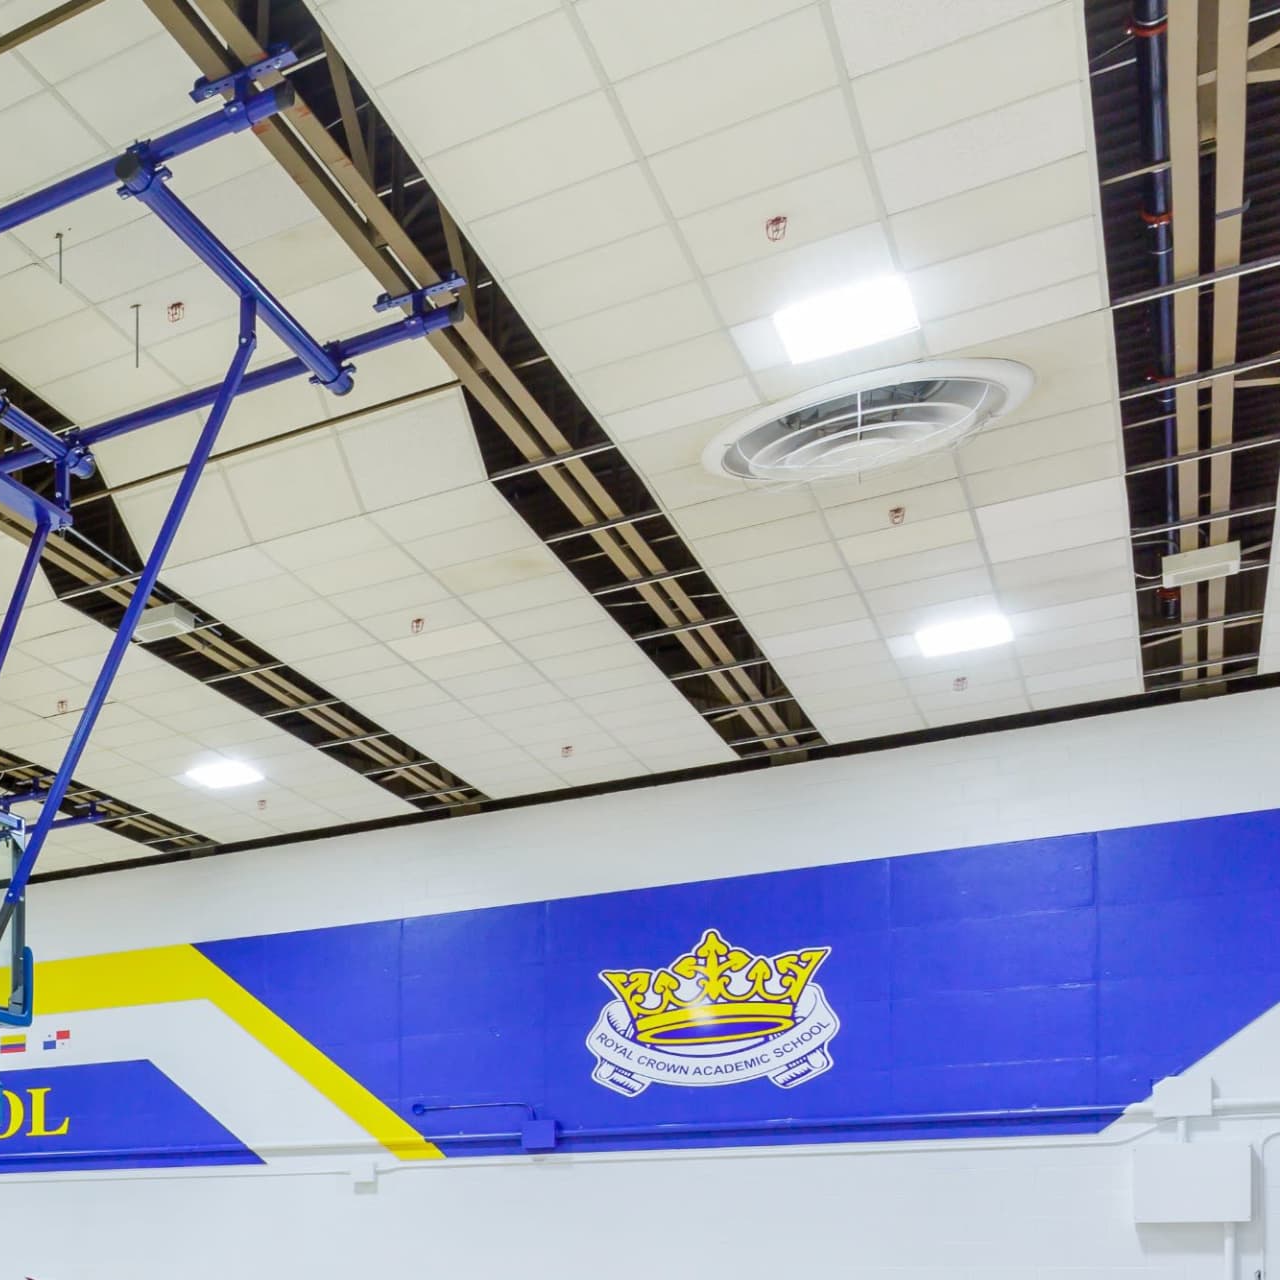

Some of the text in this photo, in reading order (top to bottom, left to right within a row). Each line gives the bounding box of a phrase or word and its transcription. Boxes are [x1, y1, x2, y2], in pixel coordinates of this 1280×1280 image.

[595, 1020, 831, 1077] ROYAL CROWN ACADEMIC SCHOOL
